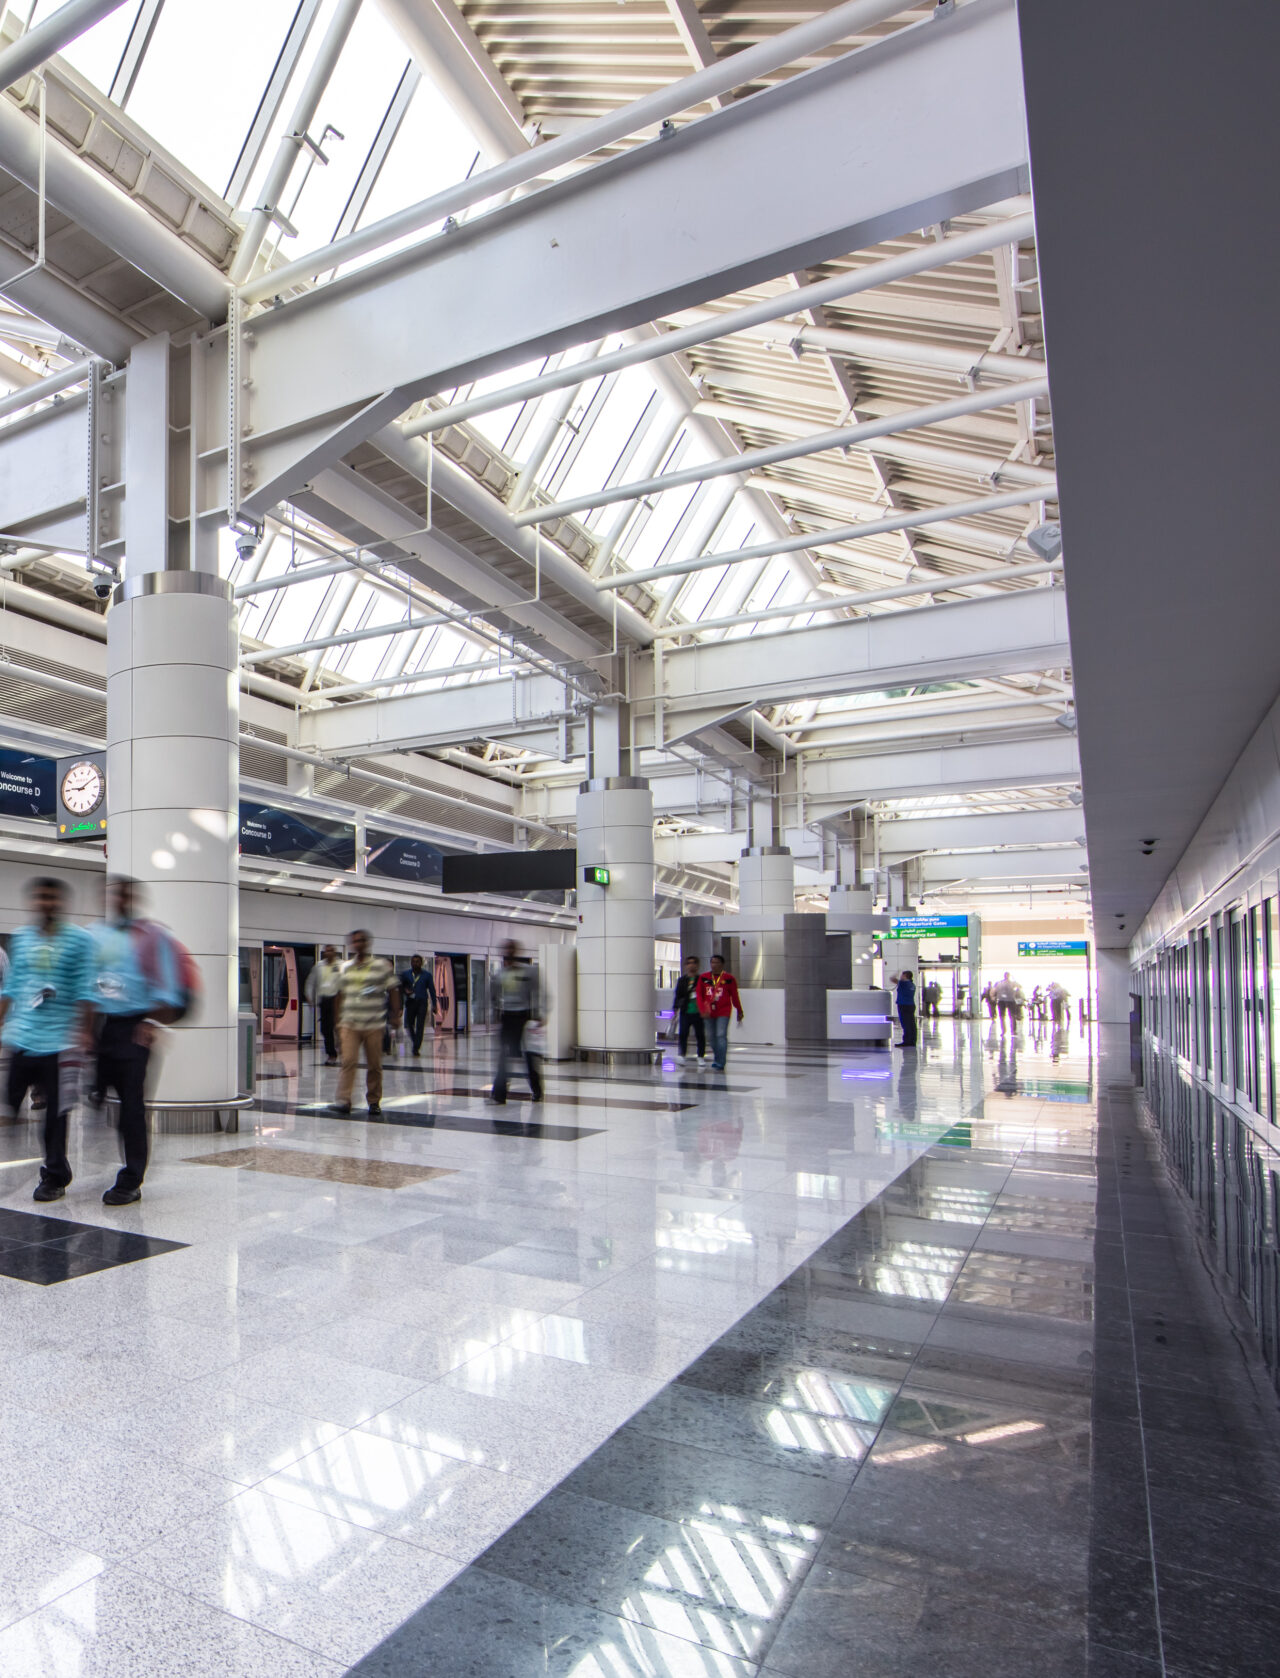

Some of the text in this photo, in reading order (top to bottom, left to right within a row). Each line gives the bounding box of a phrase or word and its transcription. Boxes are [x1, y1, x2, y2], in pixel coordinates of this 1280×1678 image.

[0, 770, 33, 784] Welcome to
[34, 786, 41, 797] D
[246, 820, 262, 829] Welcome
[241, 827, 272, 840] Concourse D
[400, 857, 417, 867] Concourse
